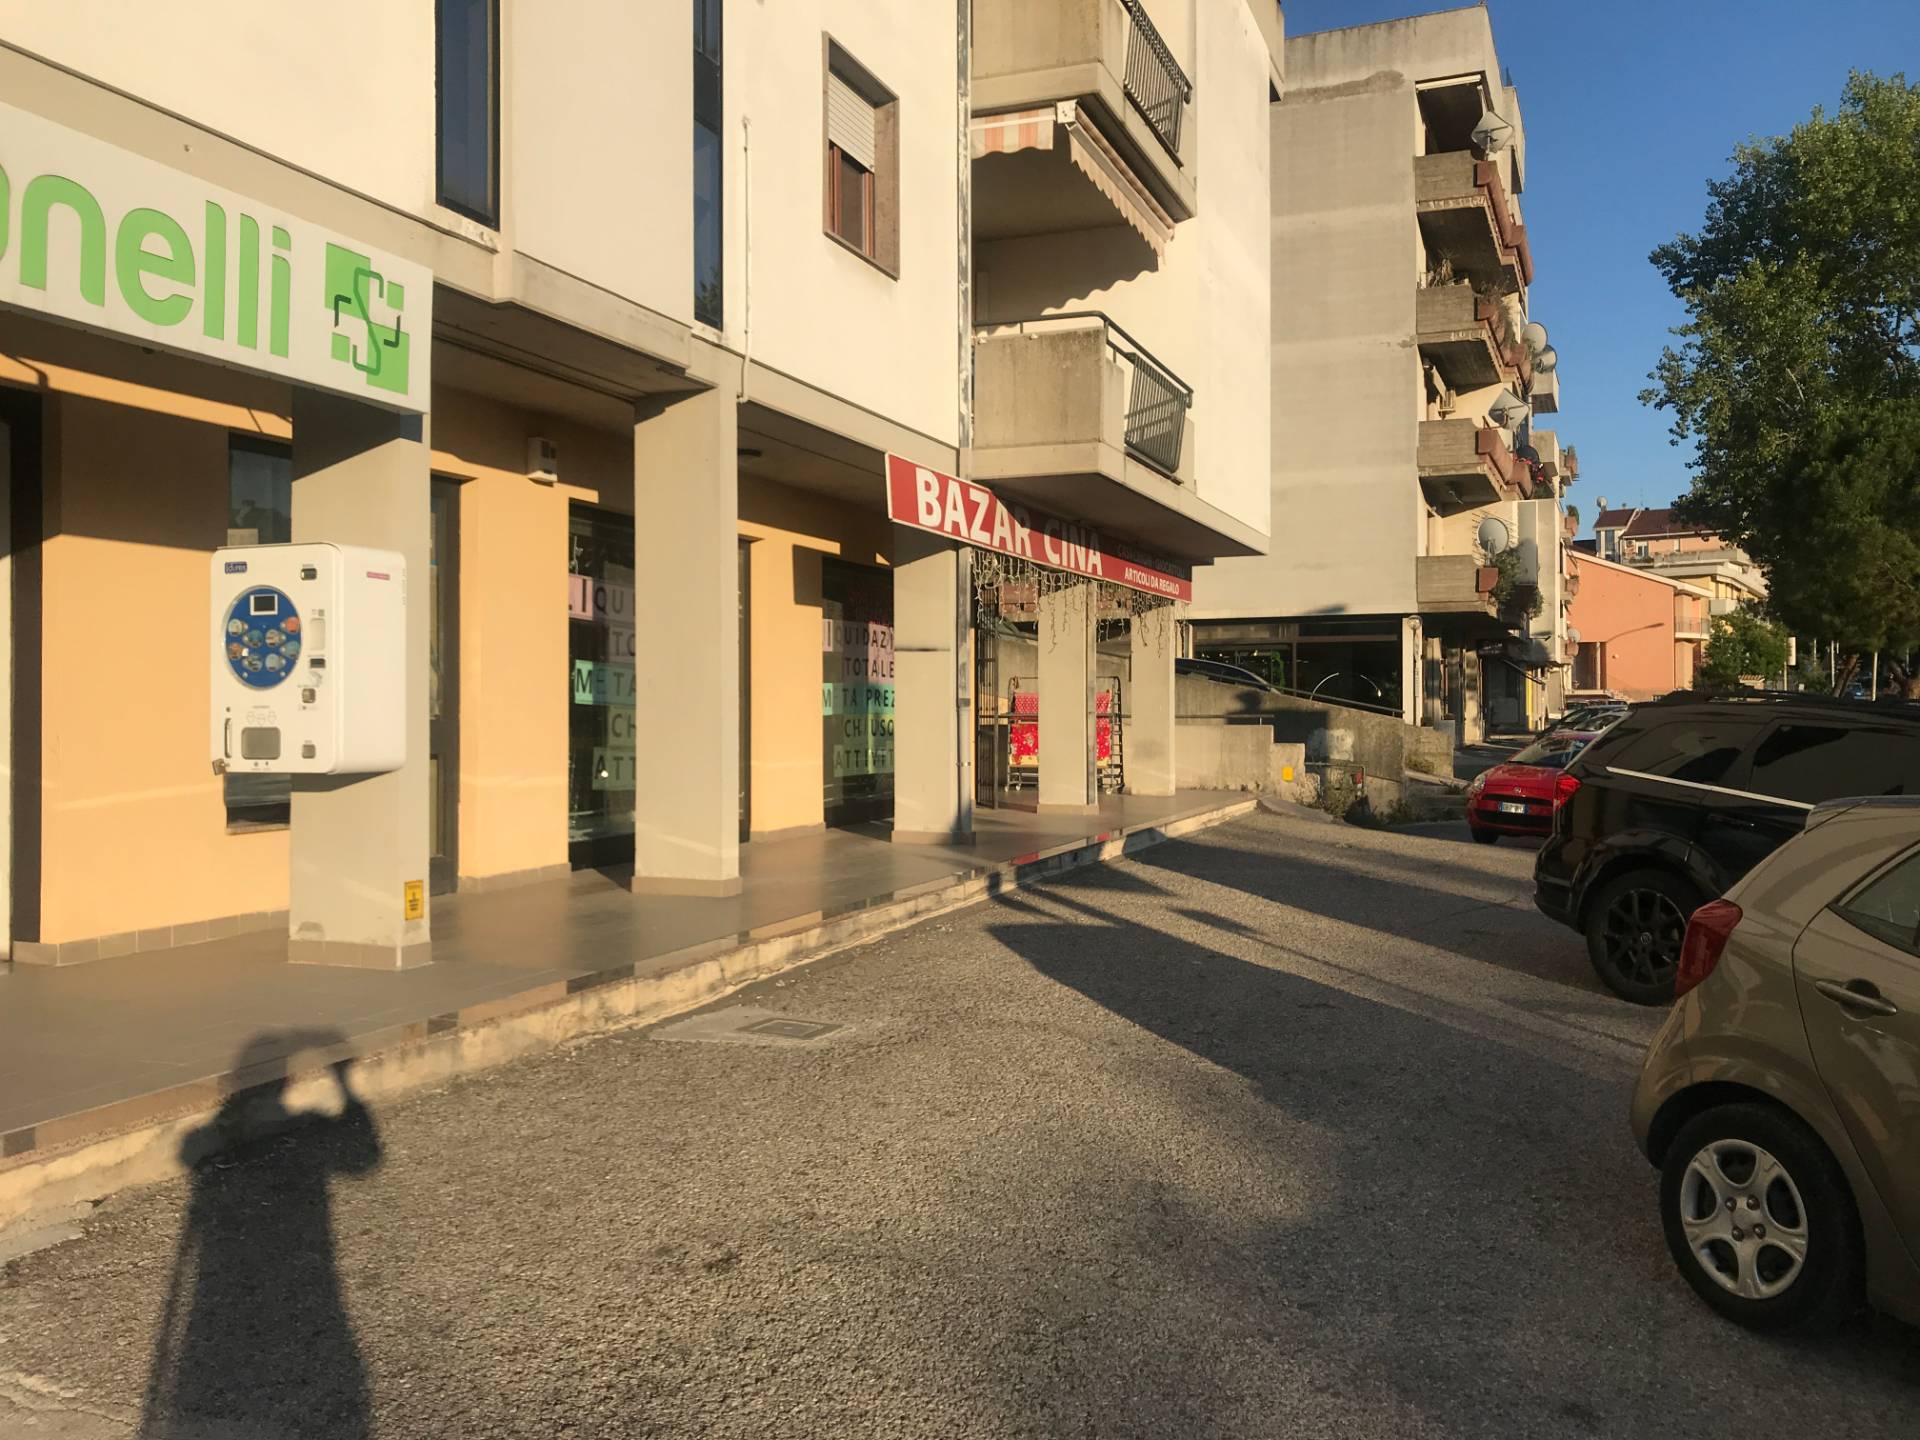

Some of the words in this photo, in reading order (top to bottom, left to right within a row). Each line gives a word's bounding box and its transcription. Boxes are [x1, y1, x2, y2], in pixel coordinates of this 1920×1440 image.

[0, 164, 291, 359] nelli
[915, 466, 1033, 558] BAZAR
[1044, 518, 1103, 576] CINA
[1124, 566, 1150, 587] ARTICOLI
[1151, 575, 1159, 590] DA
[1159, 578, 1180, 595] REGALO
[845, 657, 895, 678] TOTALE
